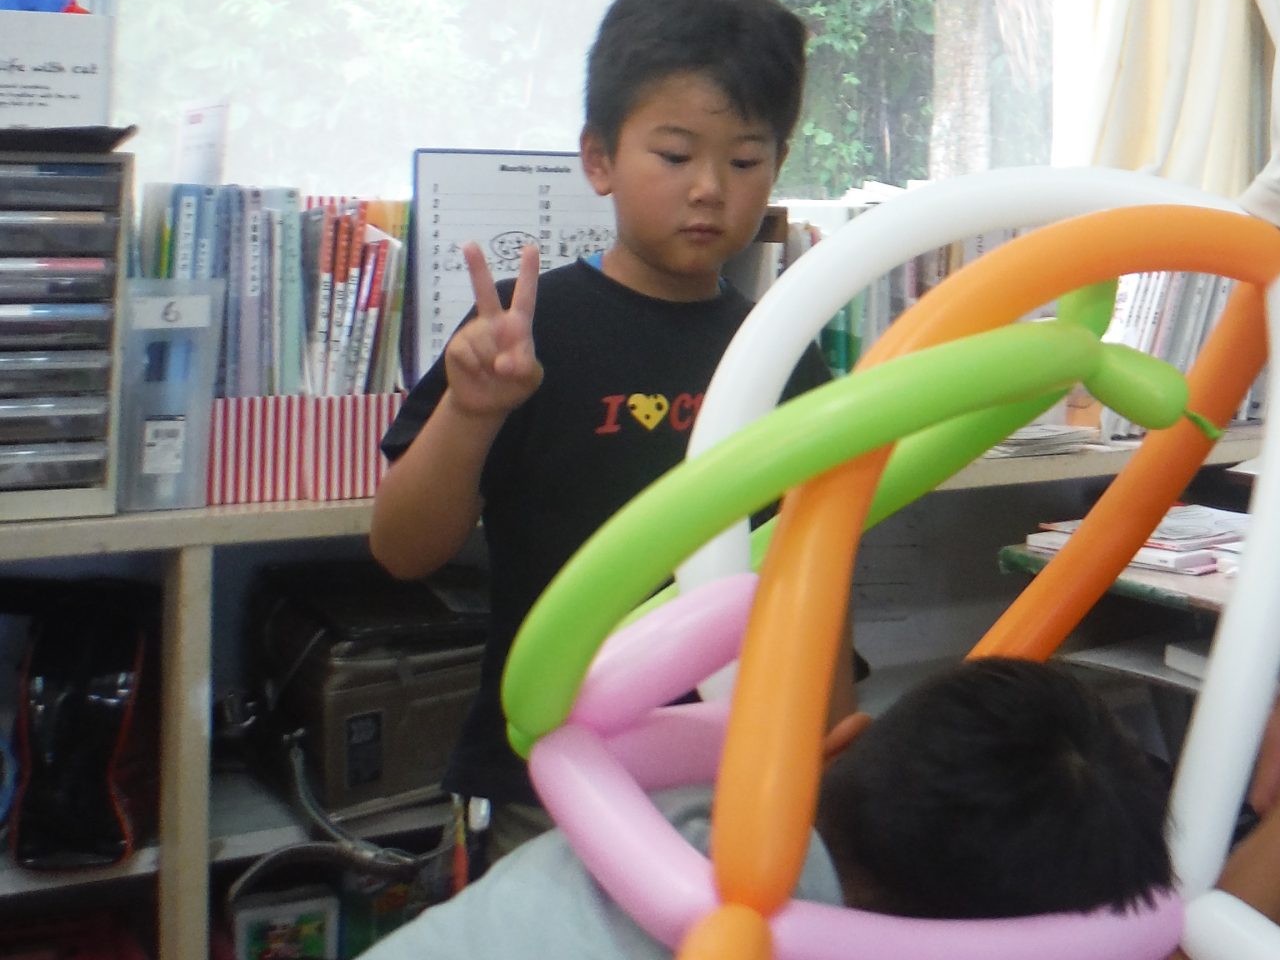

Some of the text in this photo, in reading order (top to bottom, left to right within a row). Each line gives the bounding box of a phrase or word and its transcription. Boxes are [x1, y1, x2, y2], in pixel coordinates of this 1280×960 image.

[500, 165, 571, 175] Monthly Schedule
[161, 301, 182, 326] 6
[595, 394, 626, 434] I
